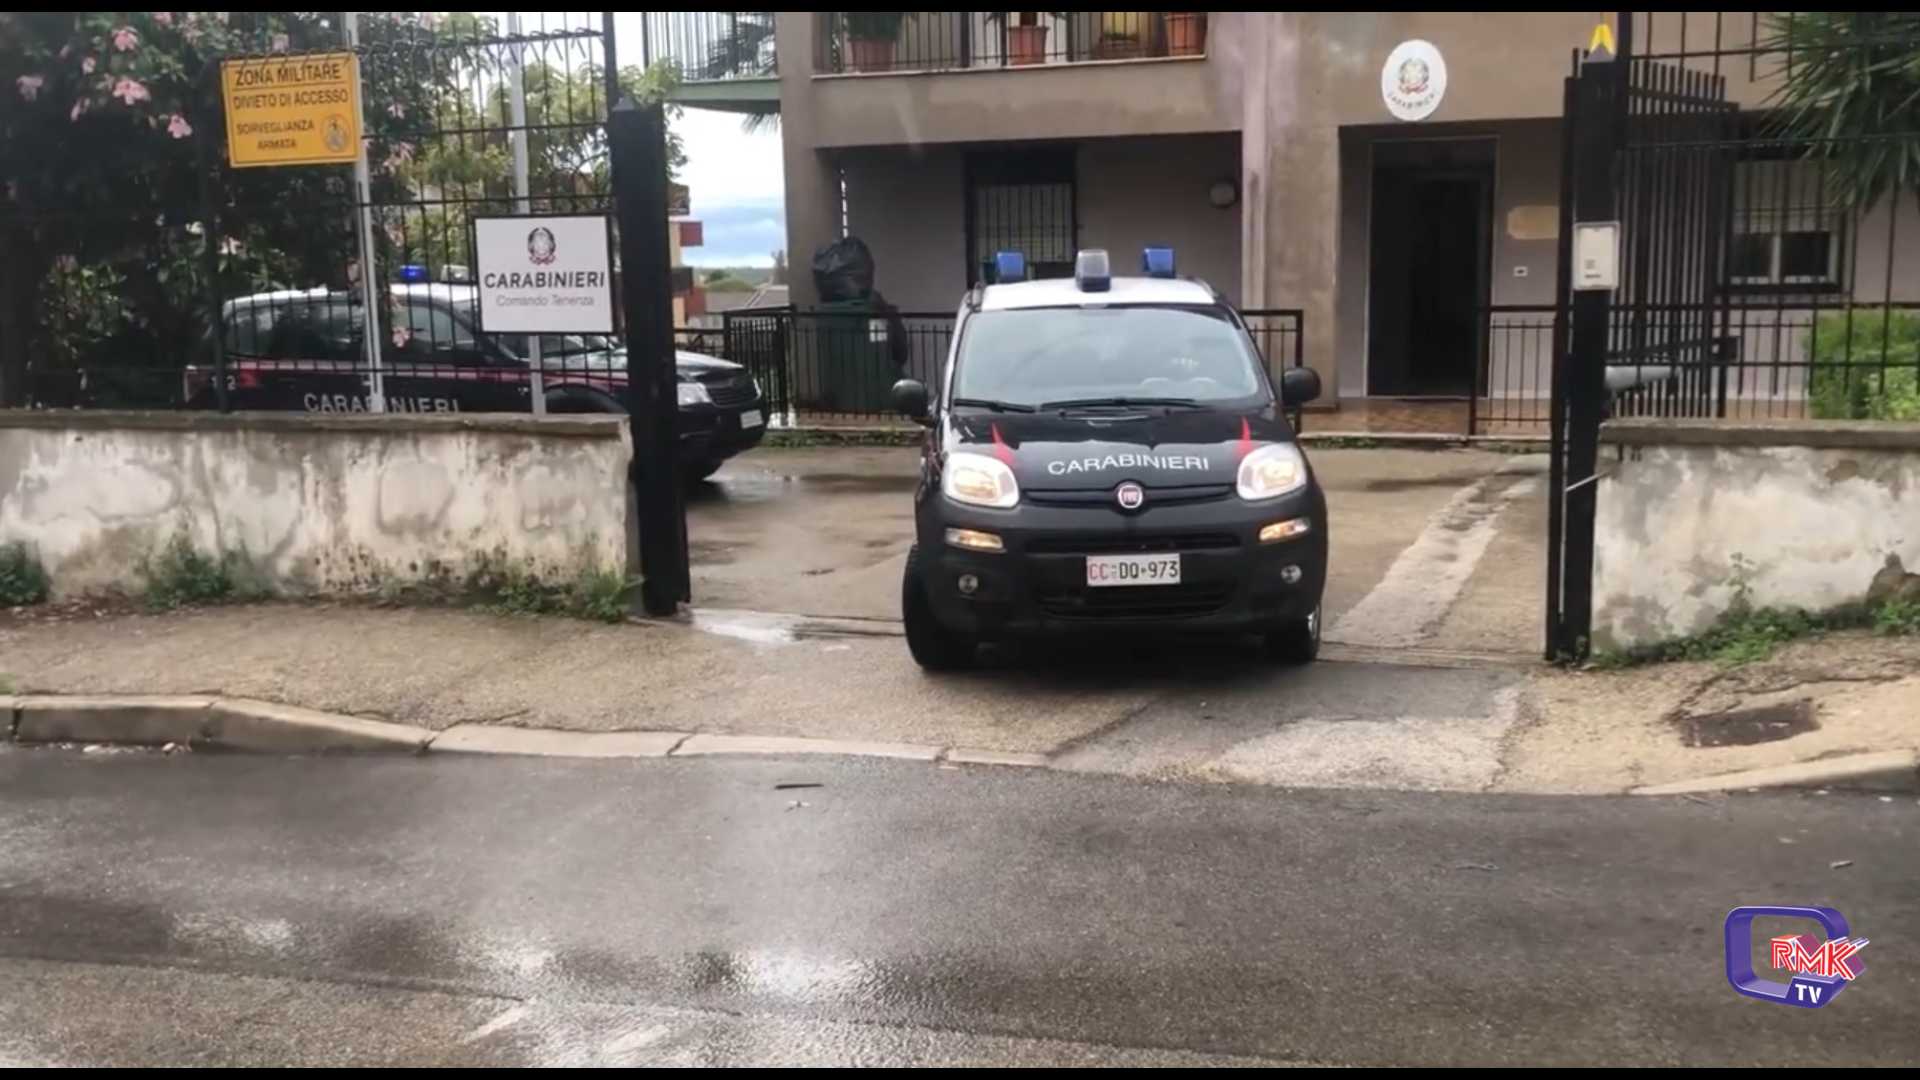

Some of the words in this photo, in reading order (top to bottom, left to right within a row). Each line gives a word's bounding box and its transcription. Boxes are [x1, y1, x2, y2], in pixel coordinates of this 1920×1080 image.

[235, 68, 274, 87] ZONA
[276, 62, 342, 83] MILITARE
[232, 93, 277, 110] DIVIETO
[279, 92, 291, 107] DI
[294, 88, 348, 105] ACCESSO
[484, 271, 605, 289] CARABINIERI
[496, 294, 549, 307] Comando
[551, 294, 594, 306] Tenenza
[1047, 453, 1209, 475] CARABINIERI
